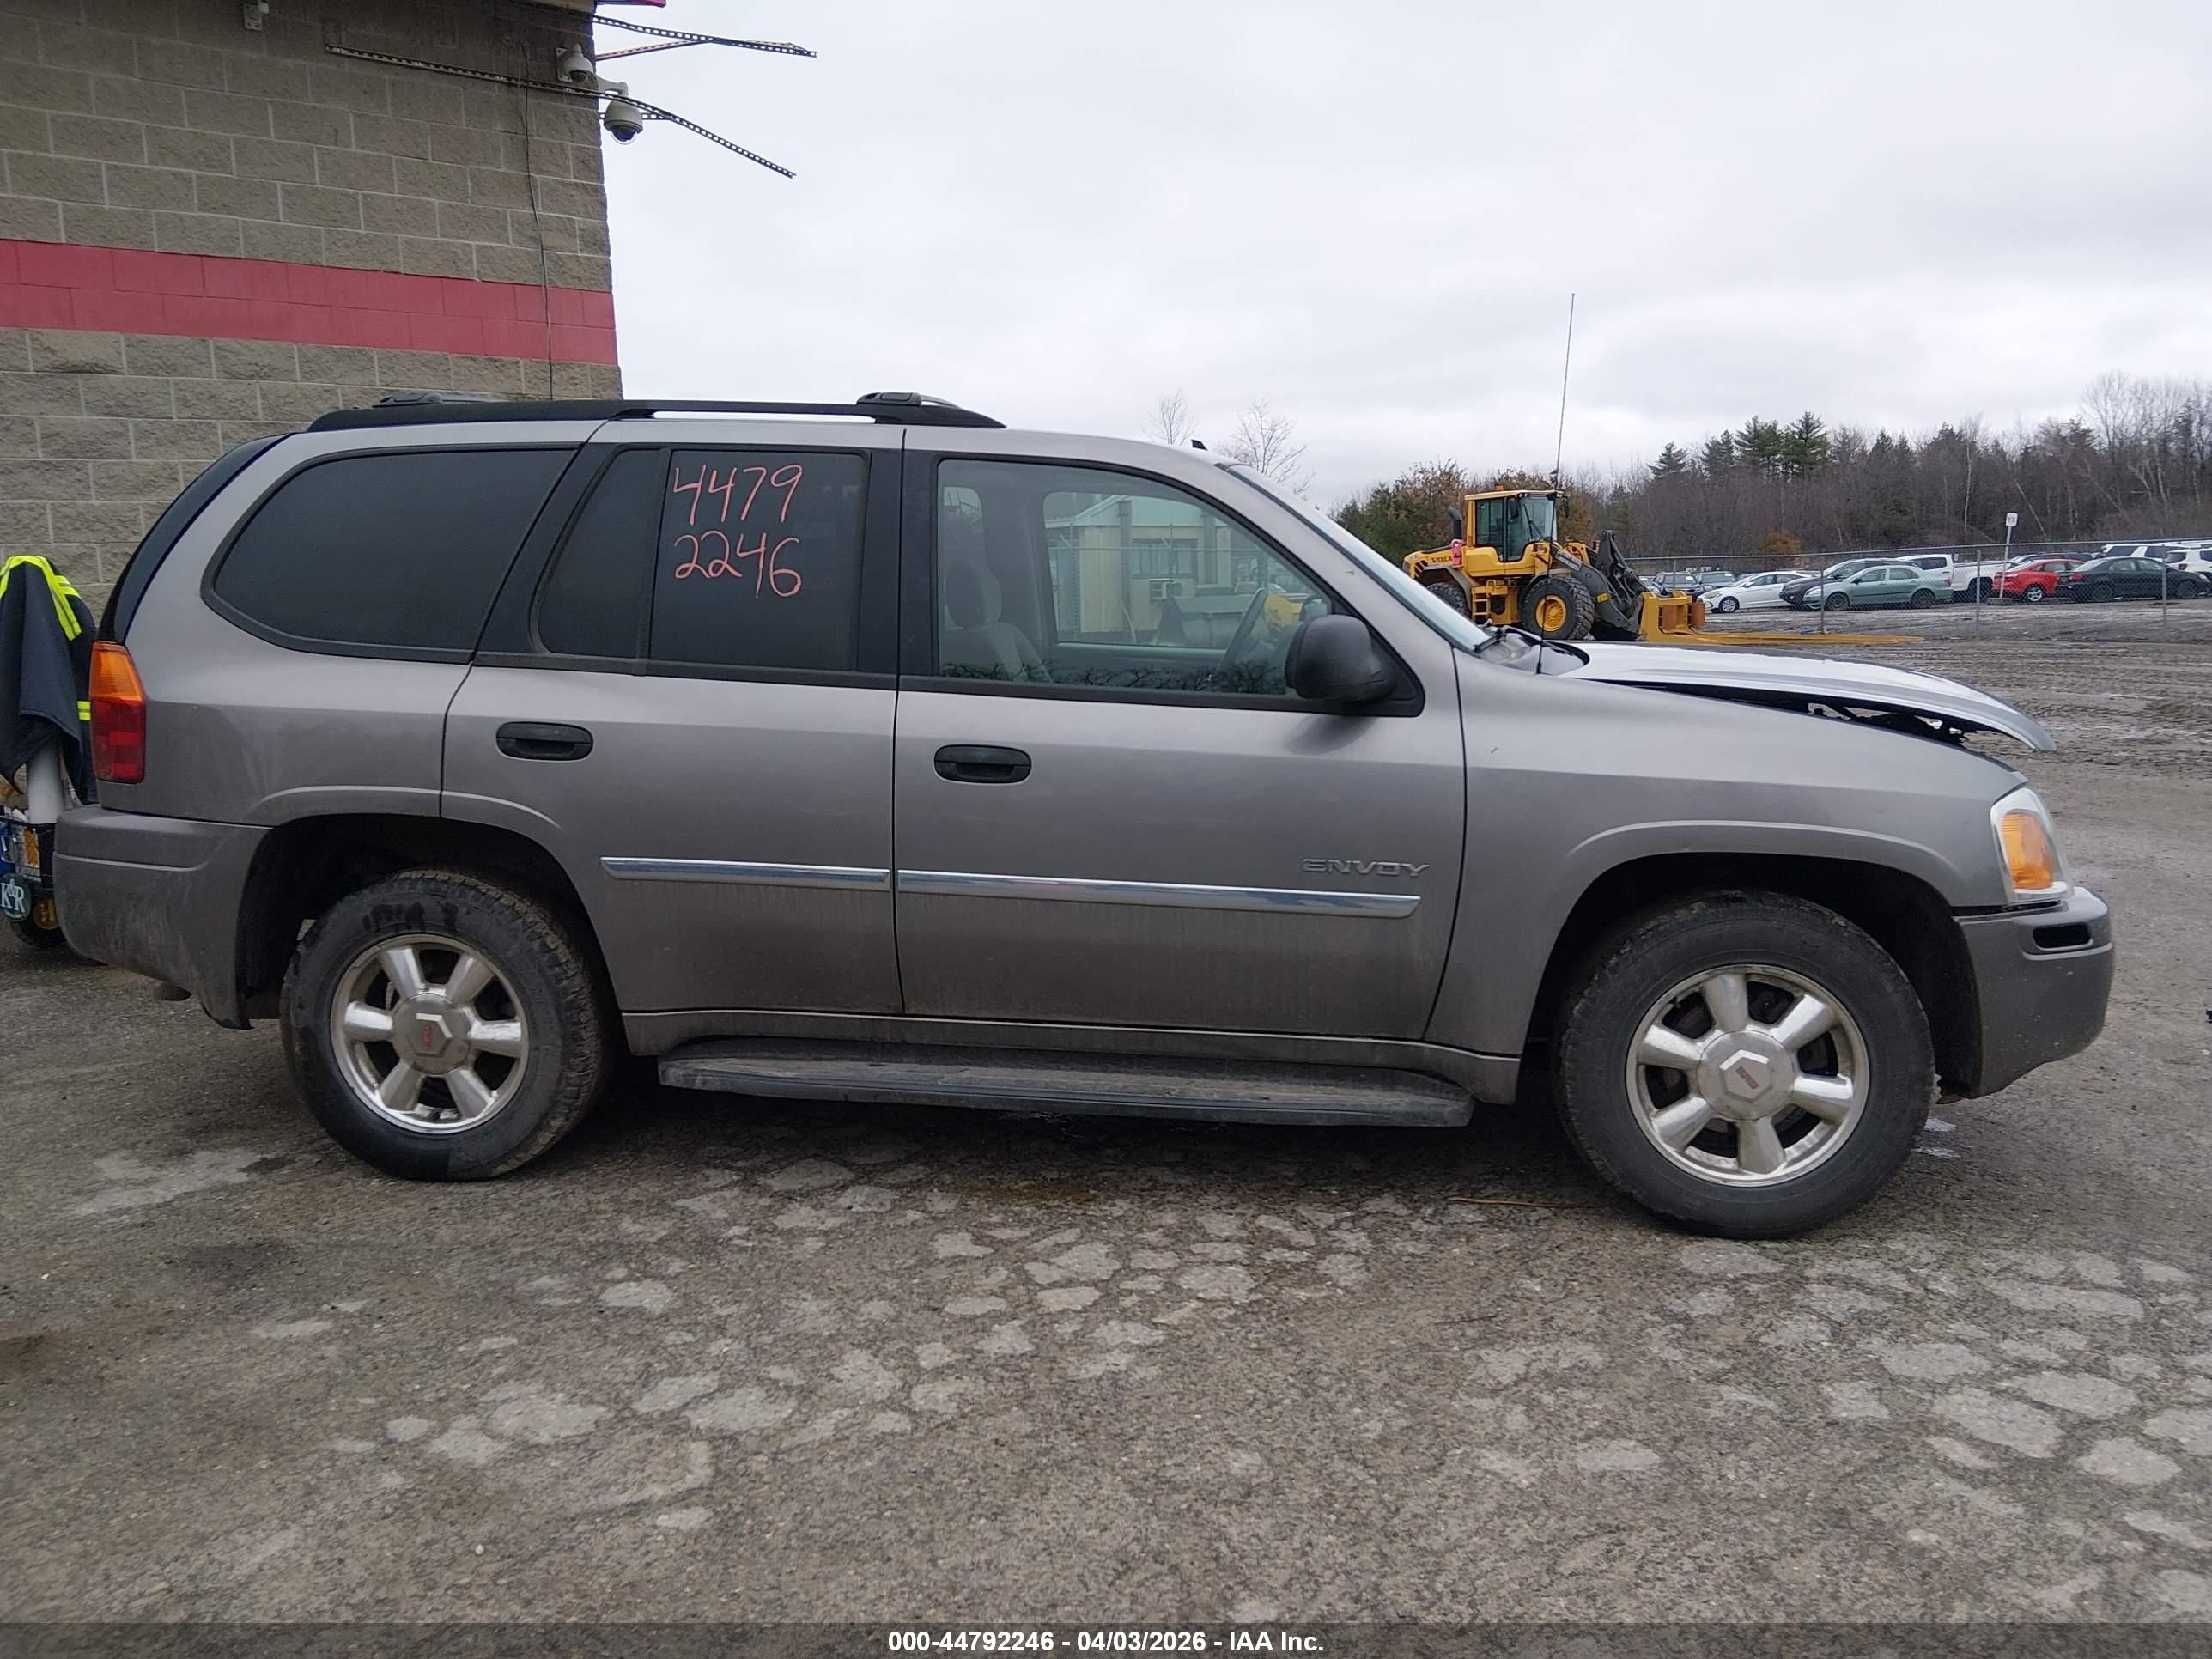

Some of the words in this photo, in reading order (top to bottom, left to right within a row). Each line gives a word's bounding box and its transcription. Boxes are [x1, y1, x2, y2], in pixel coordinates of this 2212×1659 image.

[672, 462, 804, 526] 4479
[672, 530, 803, 599] 2246
[1302, 858, 1430, 878] ENVOY
